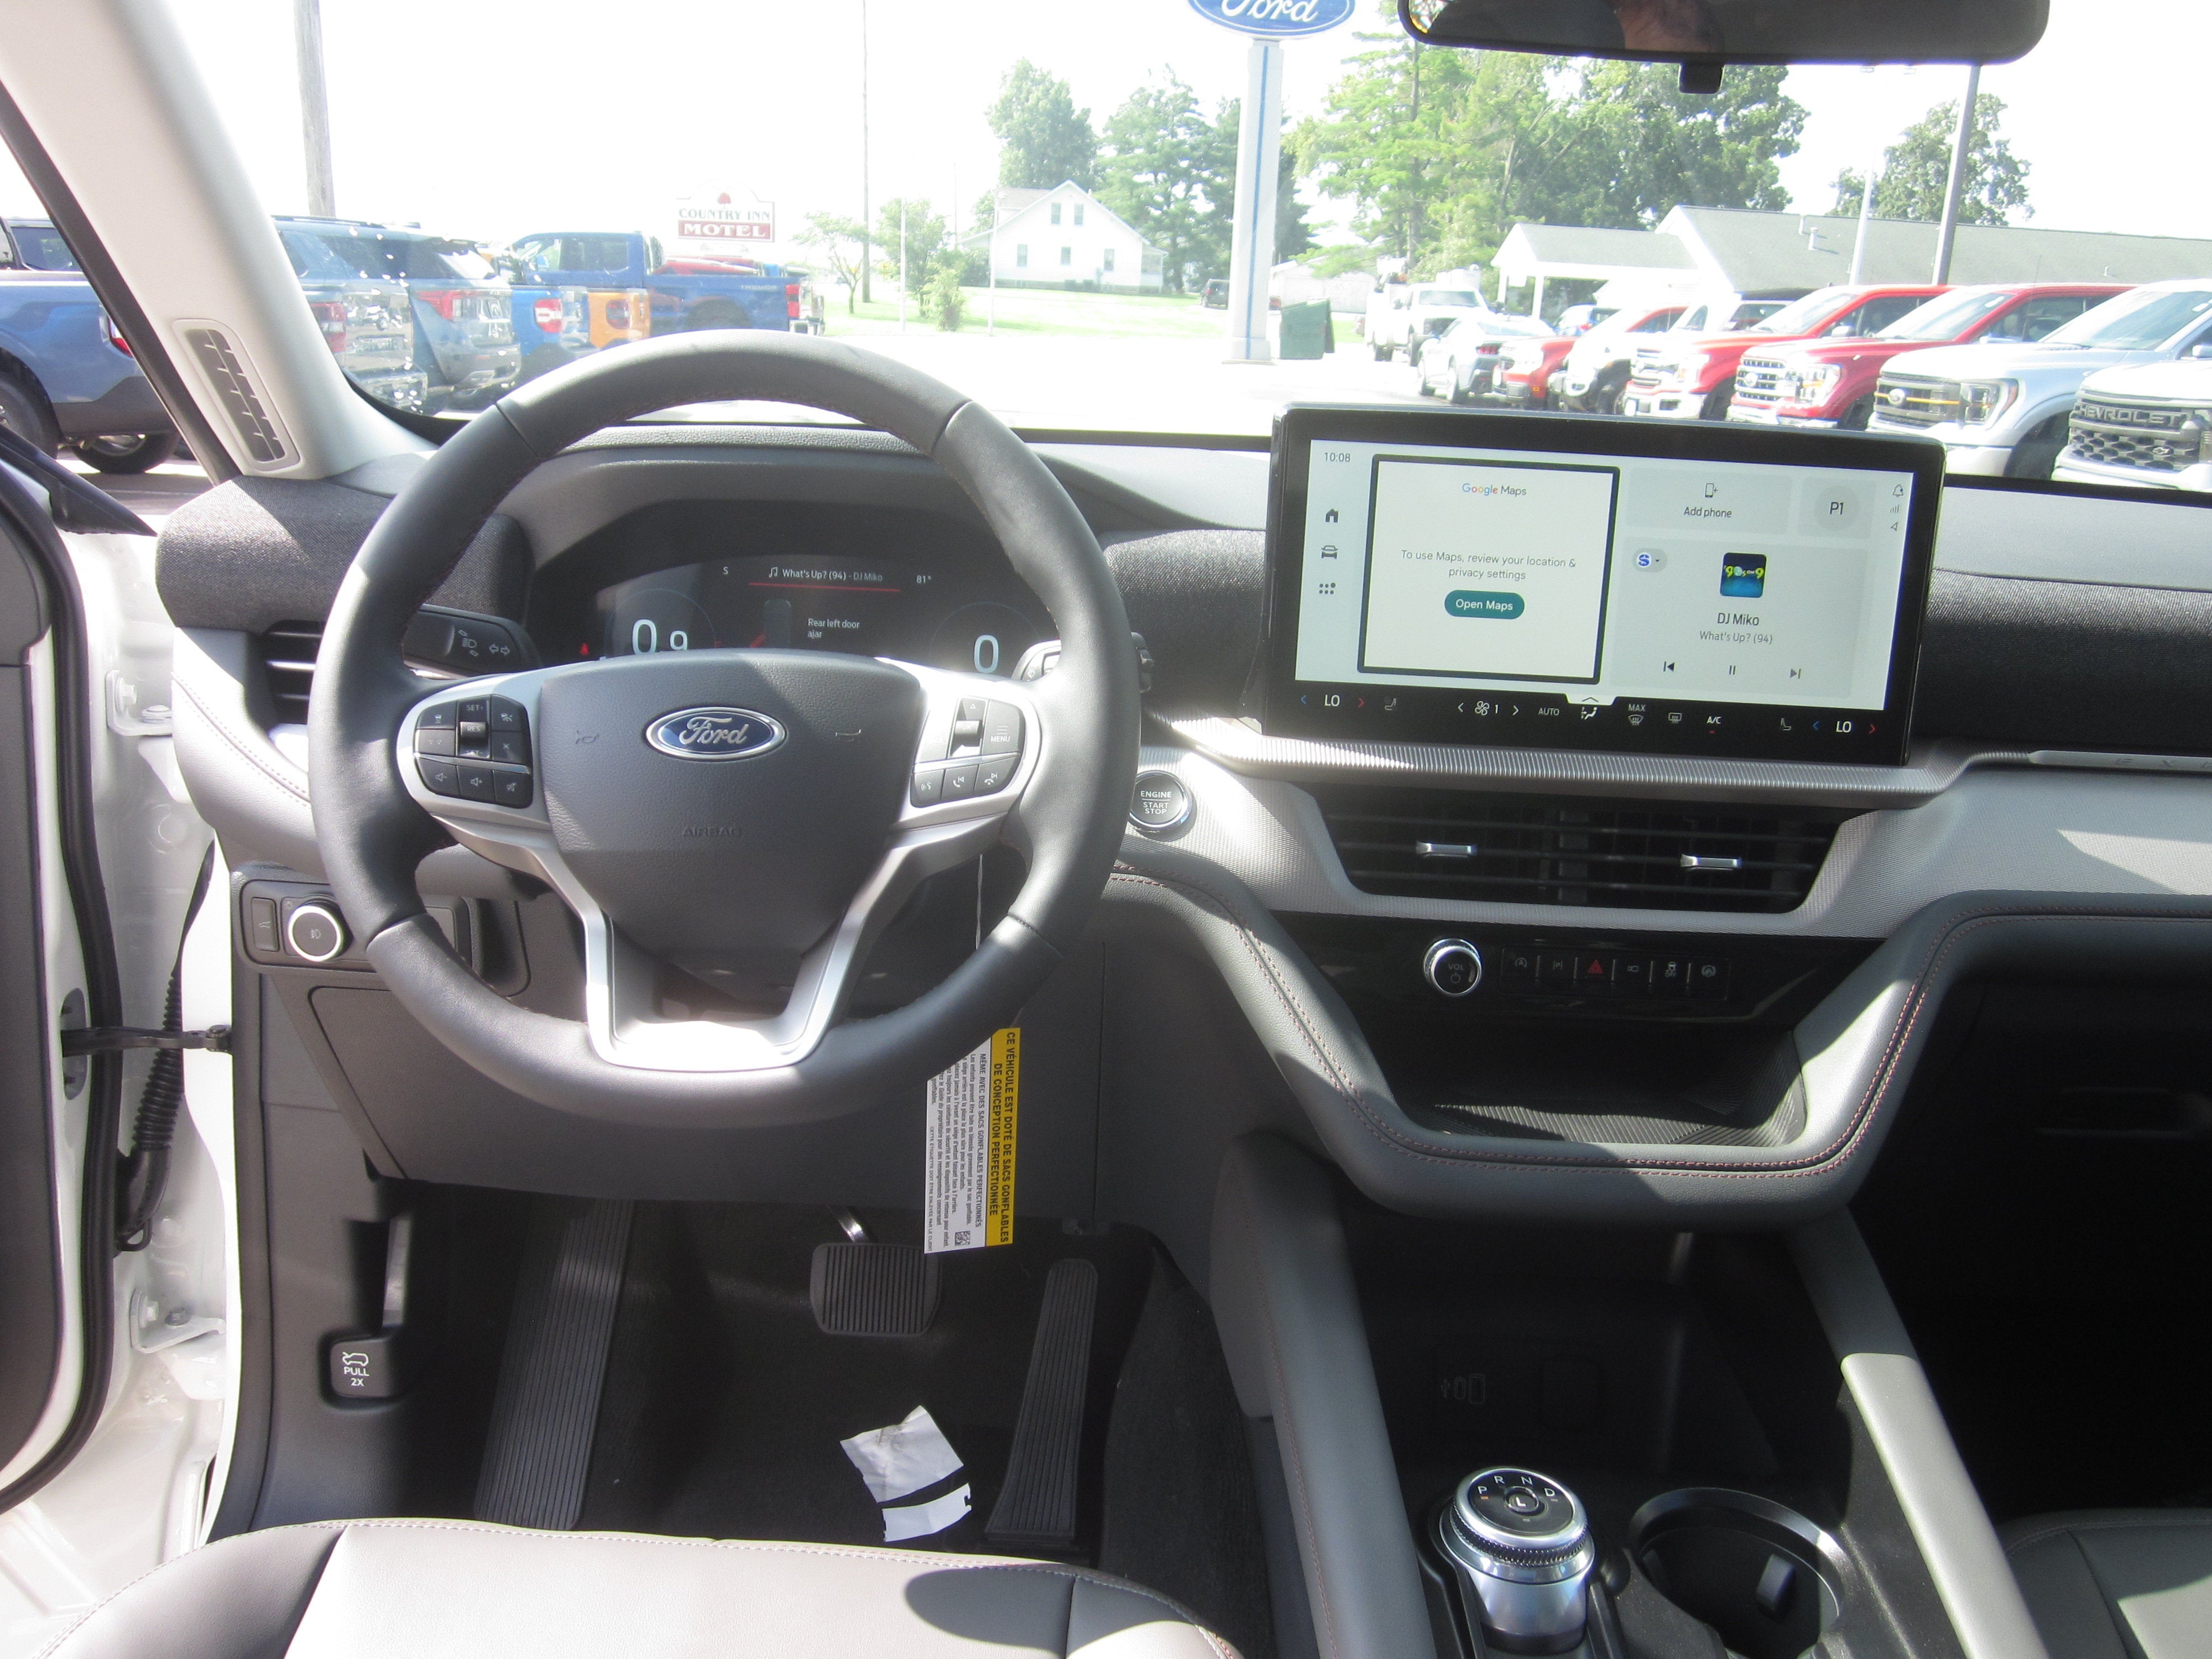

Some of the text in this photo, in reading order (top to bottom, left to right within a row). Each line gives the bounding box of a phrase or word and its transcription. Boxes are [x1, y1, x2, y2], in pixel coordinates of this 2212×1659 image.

[679, 208, 770, 221] COUNTRY INN
[684, 223, 766, 237] MOTEL
[1324, 452, 1351, 463] 10:08
[1462, 482, 1527, 497] Google Maps
[1684, 506, 1732, 518] Add phone
[1829, 501, 1844, 515] P1
[1401, 550, 1413, 560] To
[1436, 551, 1464, 563] Maps,
[1467, 554, 1499, 563] review
[1502, 556, 1524, 566] your
[1526, 555, 1566, 567] location
[1568, 559, 1576, 567] &
[723, 566, 728, 575] S
[782, 569, 883, 581] What's Up? (94) DJ Miko
[1448, 567, 1526, 581] privacy settings
[916, 575, 932, 584] 81°
[1455, 598, 1514, 612] Open Maps
[808, 618, 860, 629] Rear left door
[1717, 612, 1760, 626] DJ Miko
[807, 630, 823, 639] ajar
[1699, 630, 1773, 645] What's Up? (94)
[974, 634, 999, 674] 0
[1324, 695, 1340, 707] LO
[1494, 703, 1499, 714] 1
[1538, 707, 1560, 716] AUTO
[1628, 703, 1646, 712] MAX
[1707, 716, 1721, 724] A/C
[679, 716, 749, 745] Ford
[1835, 720, 1851, 733] LO
[990, 1063, 1002, 1215] DE CONCEPTION PERFECTIONNÉE
[1000, 1032, 1016, 1243] CE VÉHICULE EST DOTÉ DE SACS GONFLABLES
[343, 1366, 369, 1376] PULL
[351, 1378, 364, 1387] 2X
[1478, 1475, 1556, 1497] P R N D
[1516, 1496, 1526, 1507] L
